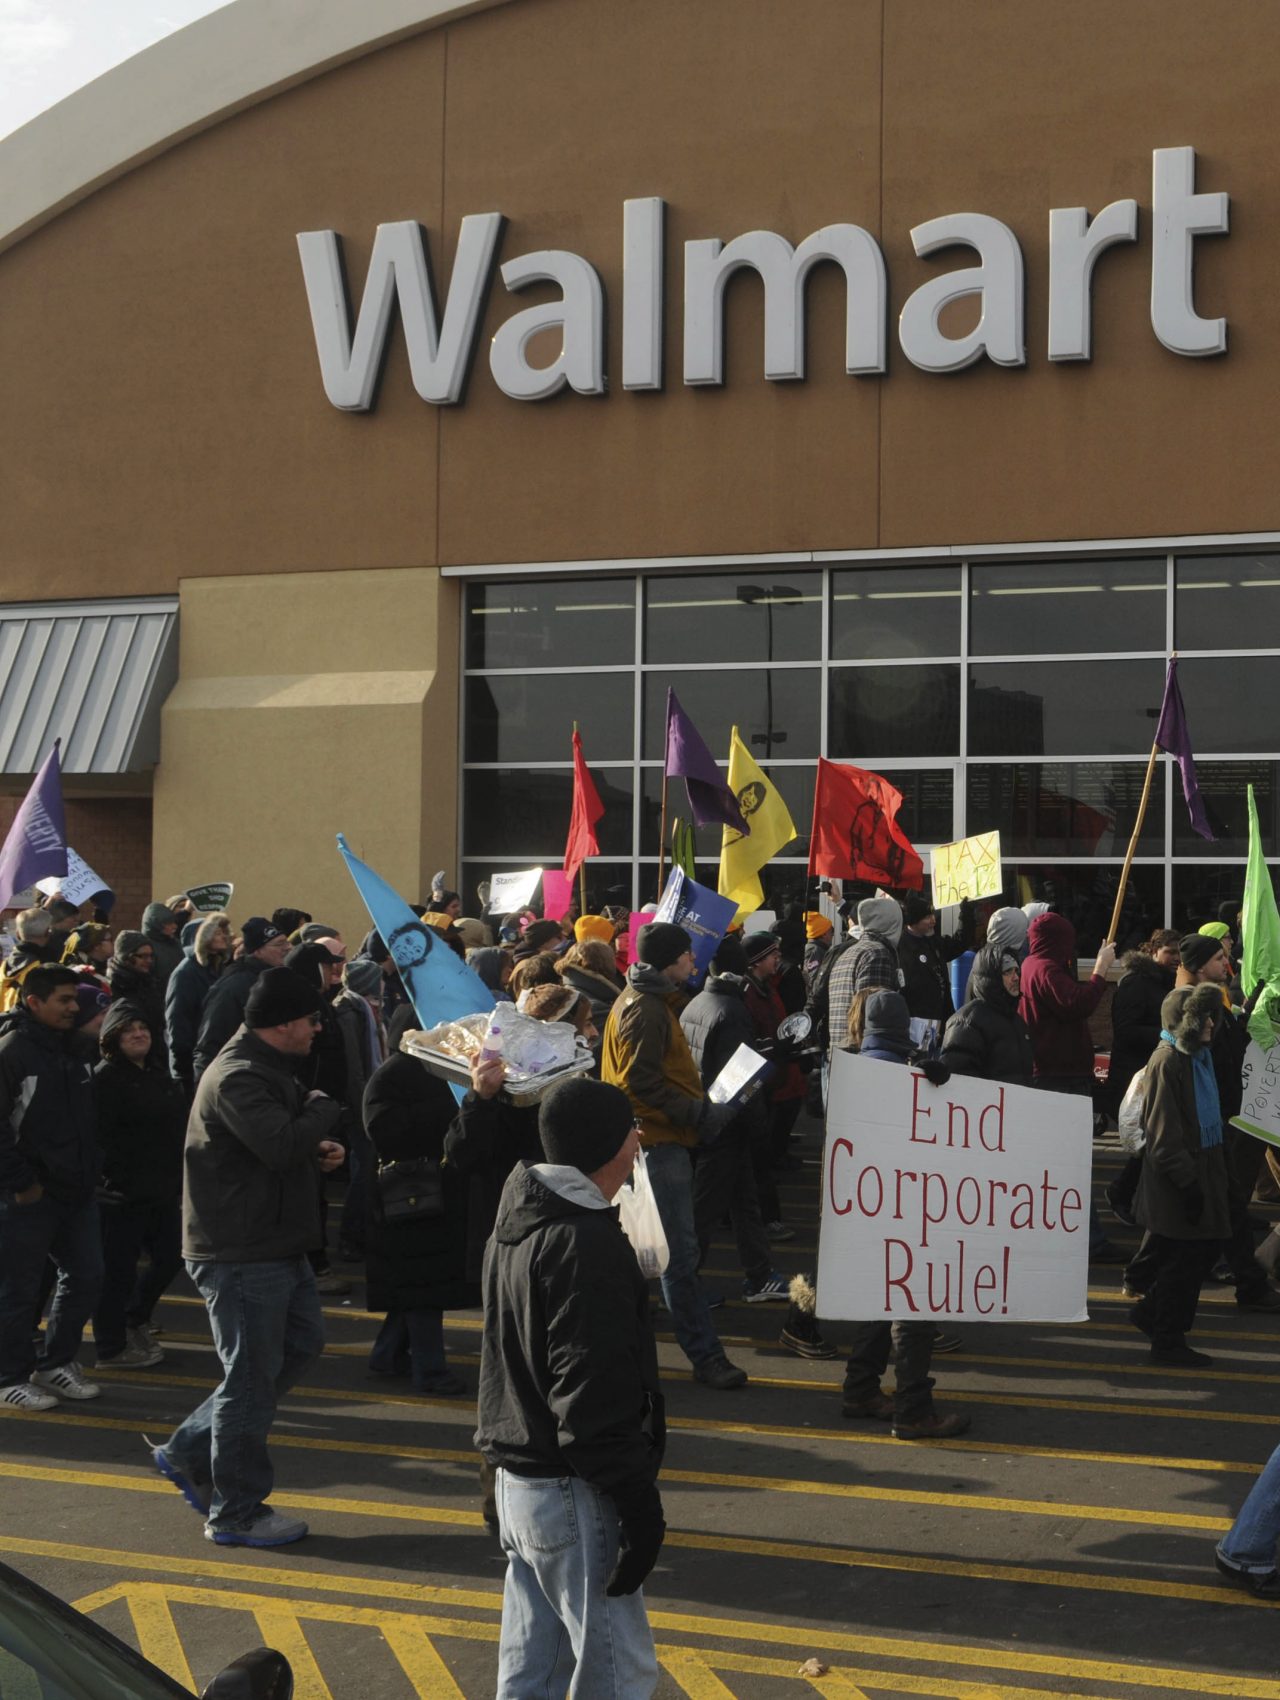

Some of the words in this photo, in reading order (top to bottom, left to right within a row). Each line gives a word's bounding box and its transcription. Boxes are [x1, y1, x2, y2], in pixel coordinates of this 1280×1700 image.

[296, 146, 1230, 412] Walmart
[937, 876, 968, 904] the
[974, 863, 997, 898] 1%
[939, 833, 996, 872] TAX
[909, 1072, 1006, 1152] End
[830, 1138, 1082, 1248] Corporate
[884, 1239, 1011, 1315] Rule!
